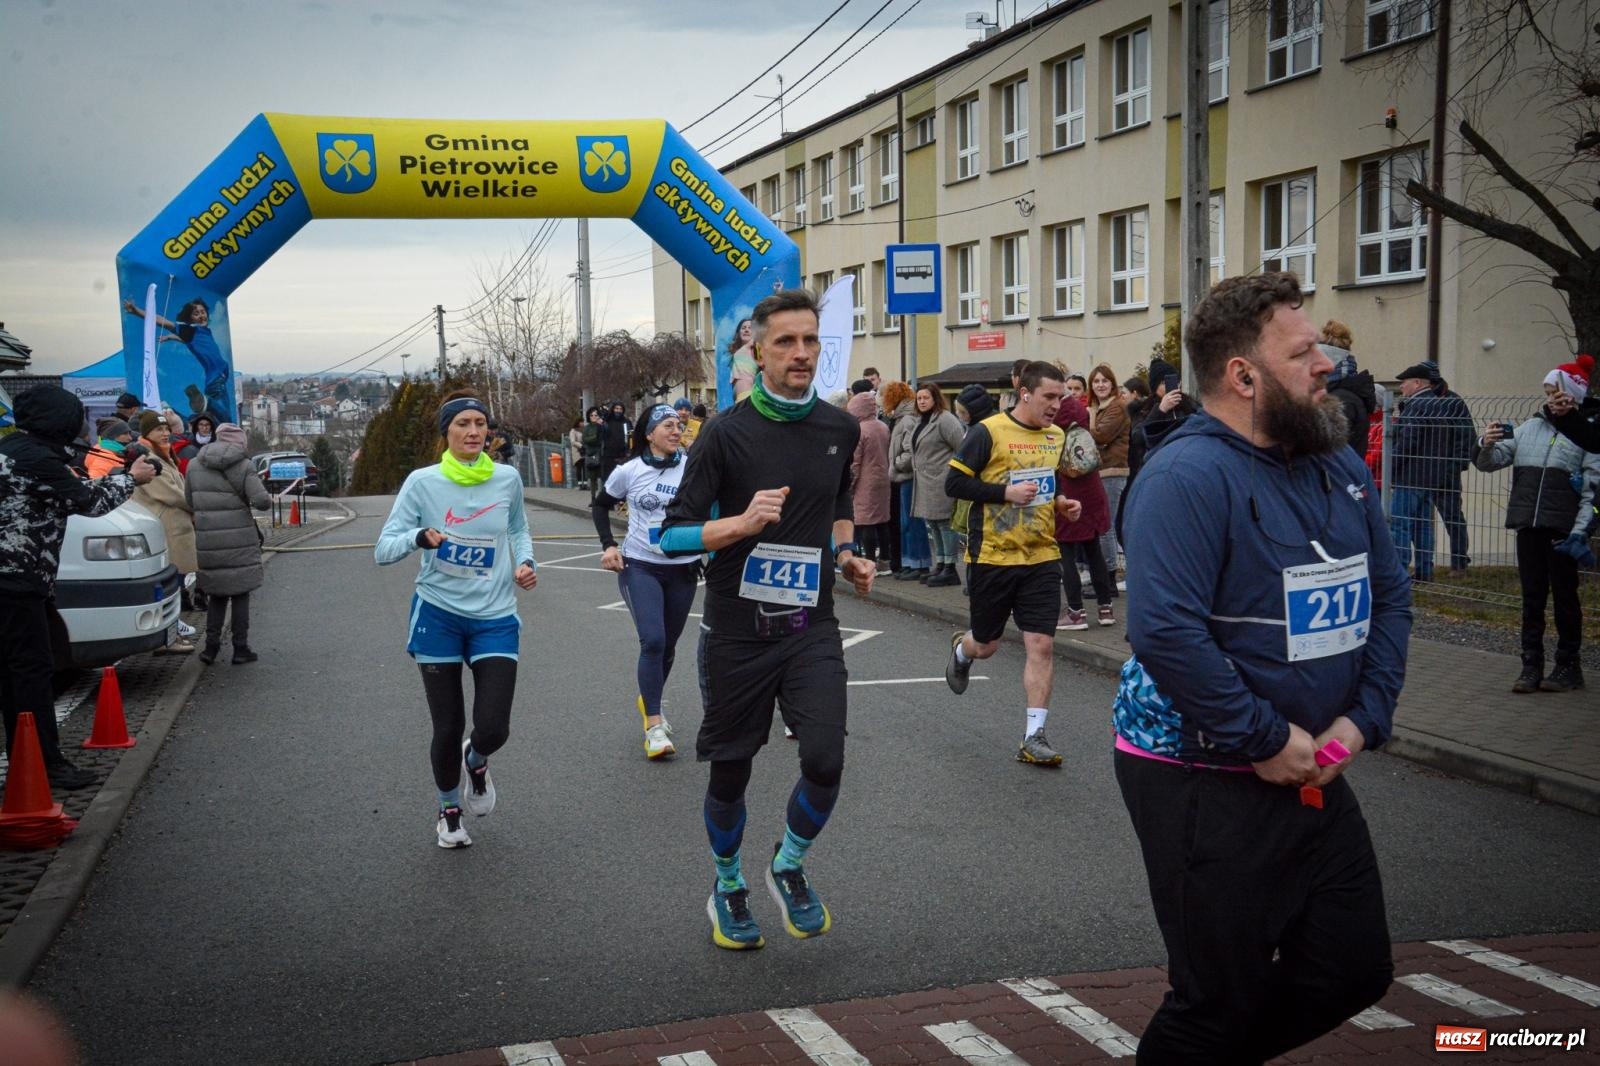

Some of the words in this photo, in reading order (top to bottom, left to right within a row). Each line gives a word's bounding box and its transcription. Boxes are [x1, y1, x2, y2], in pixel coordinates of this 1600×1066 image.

[425, 134, 529, 151] Gmina
[400, 155, 558, 175] Pietrowice
[163, 202, 229, 259] Gmina
[220, 152, 276, 205] ludzi
[421, 180, 538, 198] Wielkie
[670, 157, 725, 215] Gmina
[723, 207, 772, 255] ludzi
[191, 180, 296, 279] aktywnych
[654, 181, 751, 272] aktywnych
[446, 544, 486, 566] 142
[758, 560, 807, 588] 141
[1307, 582, 1362, 629] 217
